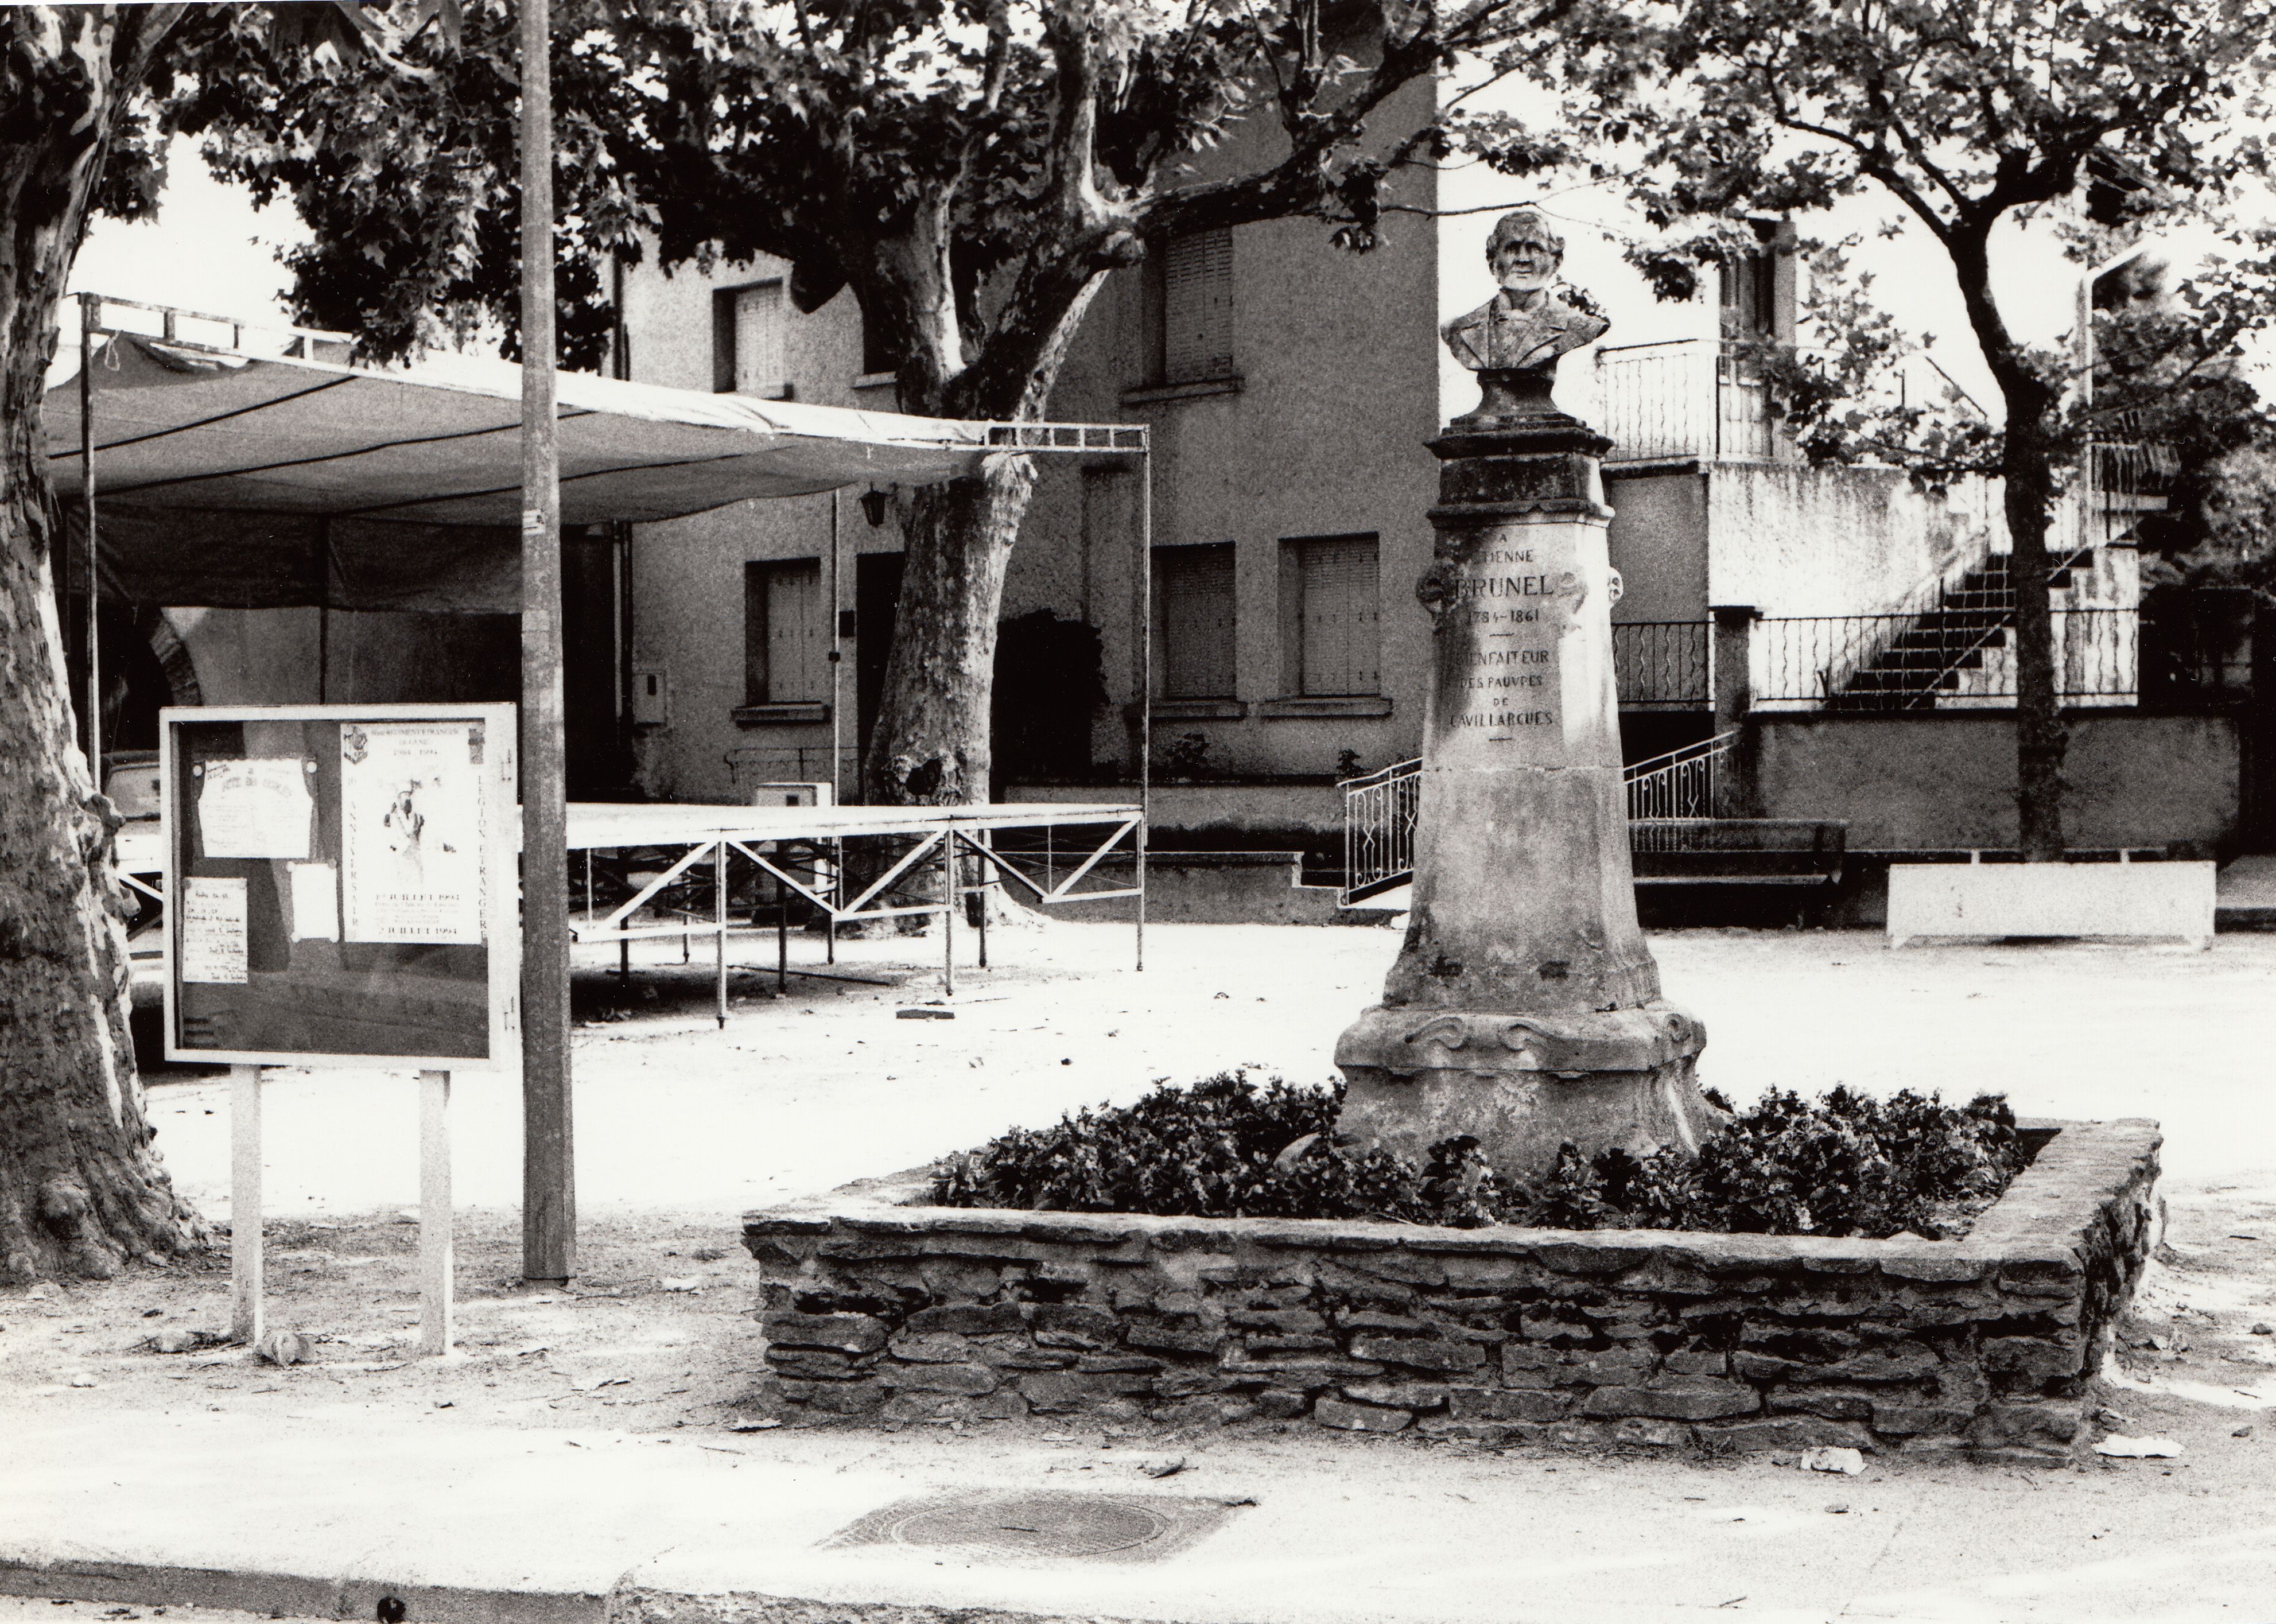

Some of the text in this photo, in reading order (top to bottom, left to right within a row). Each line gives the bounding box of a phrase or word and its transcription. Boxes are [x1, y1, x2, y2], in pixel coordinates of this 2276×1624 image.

[1455, 575, 1555, 599] BRUNEL
[1460, 677, 1484, 689] DES
[1493, 697, 1509, 707] DE
